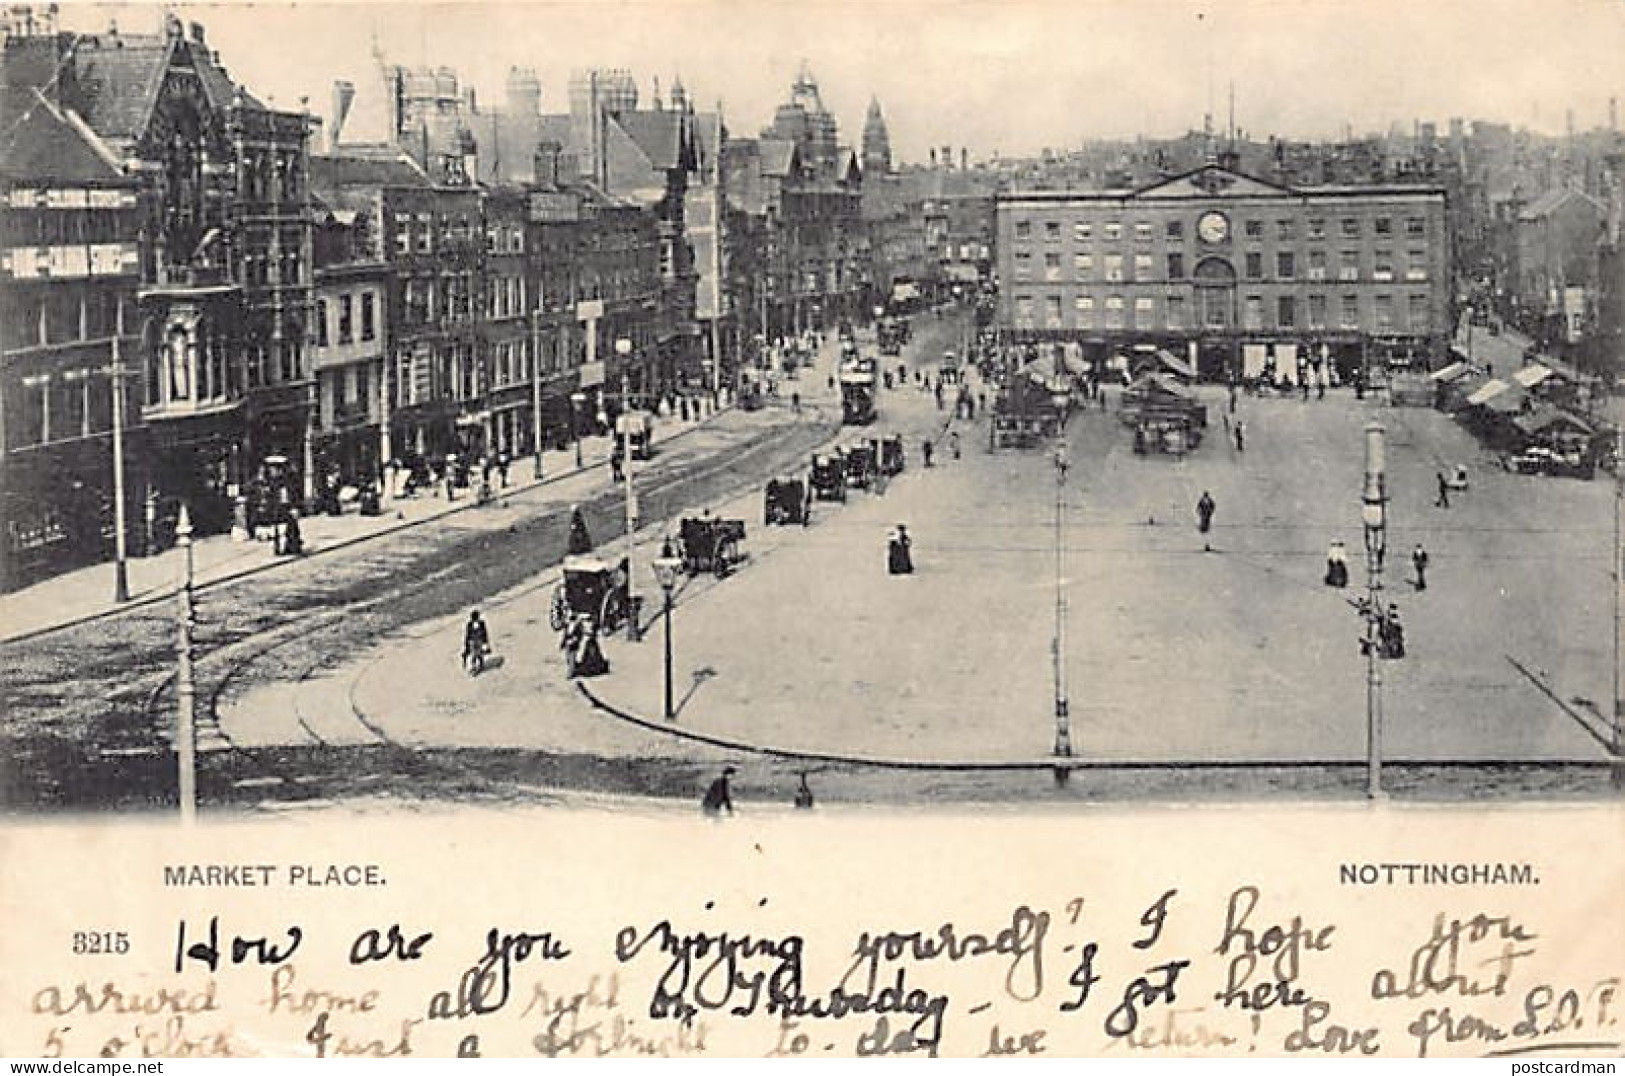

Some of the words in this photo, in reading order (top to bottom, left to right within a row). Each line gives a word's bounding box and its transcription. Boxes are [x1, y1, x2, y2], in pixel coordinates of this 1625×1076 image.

[164, 865, 275, 886] MARKET
[289, 865, 388, 886] PLACE.
[1340, 864, 1540, 885] NOTTINGHAM.
[72, 932, 130, 954] 3215
[175, 916, 302, 973] How
[349, 924, 433, 965] are
[478, 928, 572, 1014] you
[616, 898, 803, 1009] enjoying
[1132, 889, 1177, 949] I
[1214, 886, 1337, 984] hope
[1423, 912, 1539, 988] you
[31, 980, 220, 1015] arrived
[260, 963, 380, 1014] home
[427, 966, 497, 1019] all
[519, 972, 620, 1032] right
[731, 966, 949, 1058] Thursday
[1059, 943, 1100, 1012] I
[1104, 960, 1191, 1037] got
[1214, 953, 1313, 1011] here
[1372, 942, 1536, 1001] about
[985, 1026, 1047, 1058] we
[1284, 1001, 1380, 1055] Love
[1408, 1007, 1508, 1058] from
